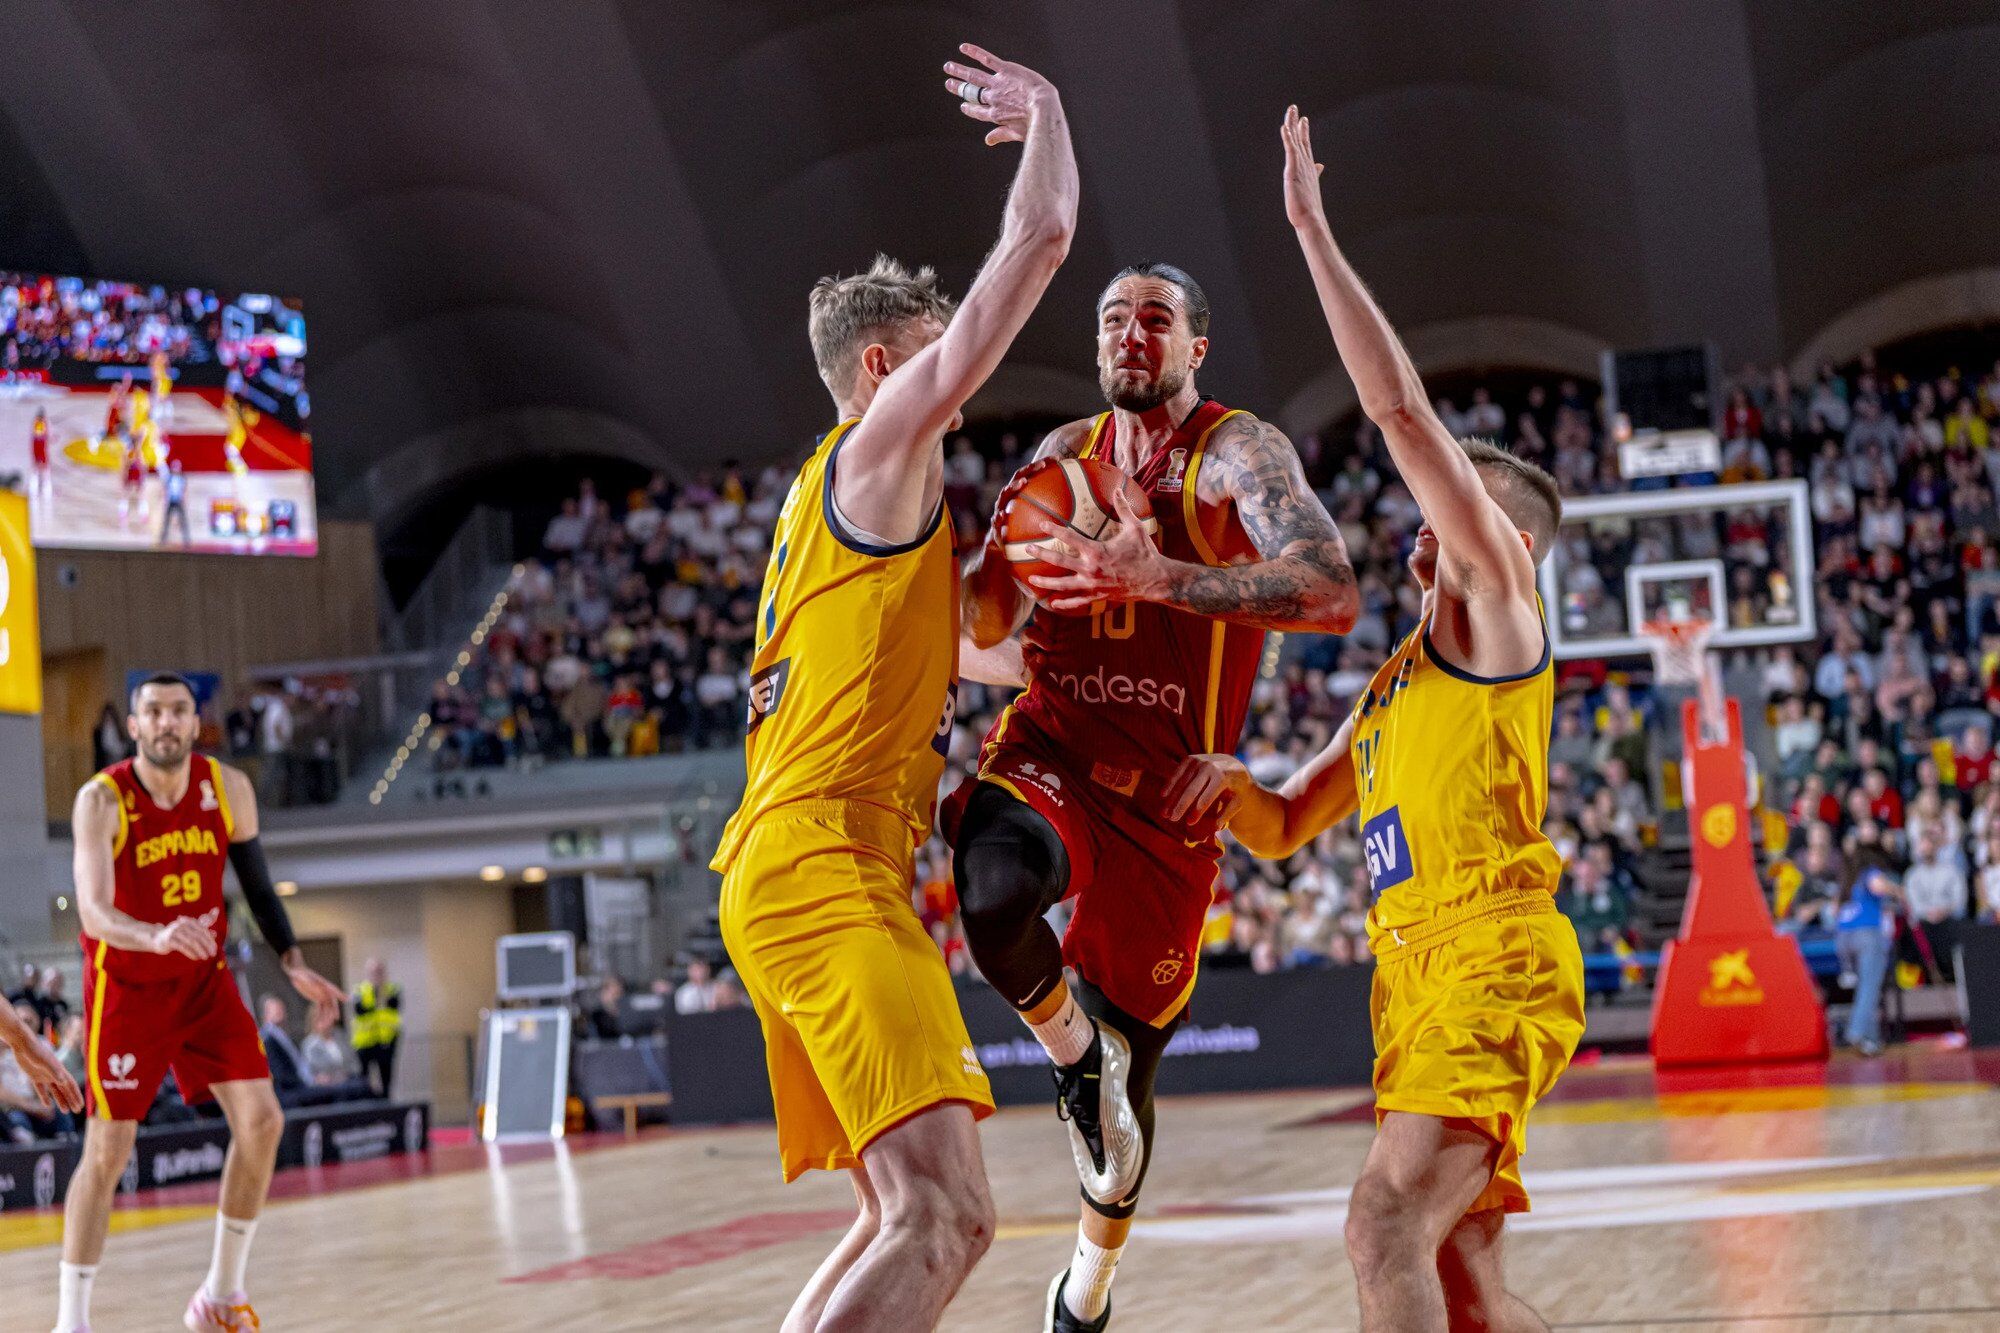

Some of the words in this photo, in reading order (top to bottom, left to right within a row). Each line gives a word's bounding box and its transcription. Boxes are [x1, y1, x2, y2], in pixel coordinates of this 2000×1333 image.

[1048, 665, 1186, 715] ndesa
[136, 825, 219, 868] ESPAÑA
[161, 869, 202, 907] 29
